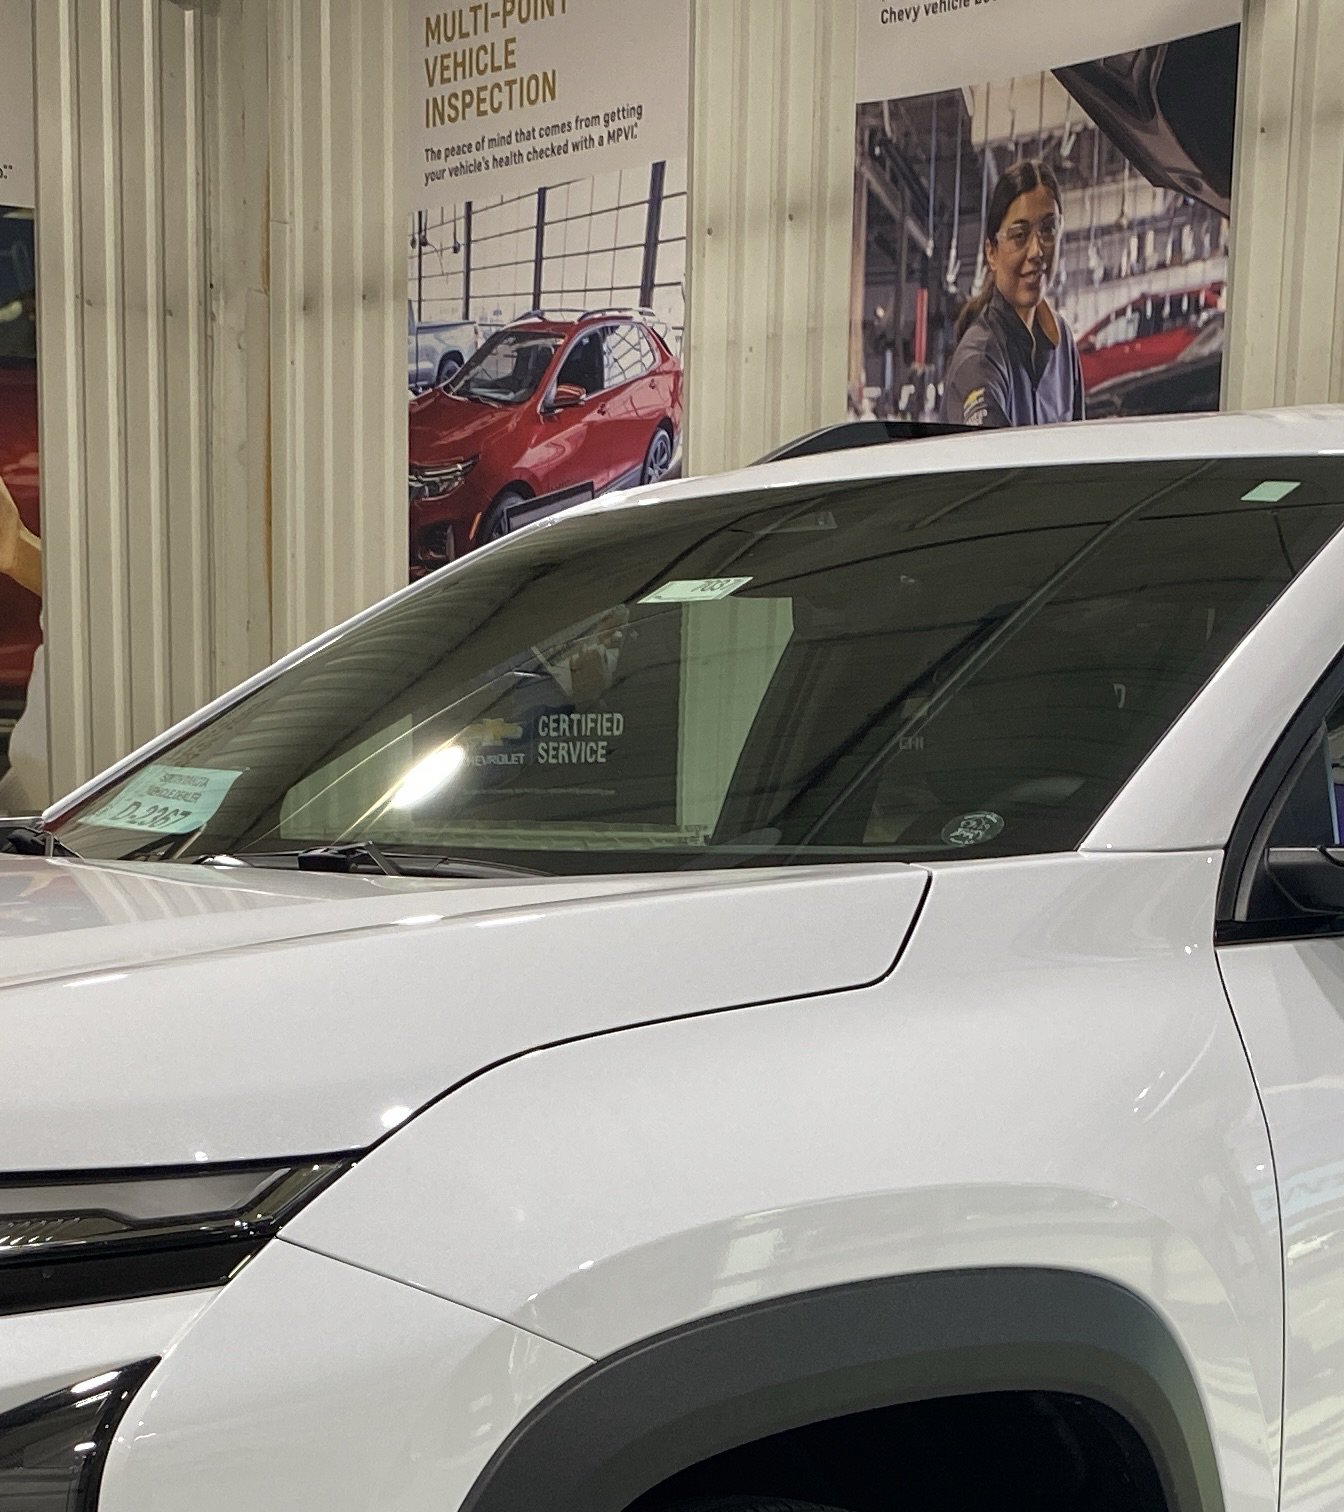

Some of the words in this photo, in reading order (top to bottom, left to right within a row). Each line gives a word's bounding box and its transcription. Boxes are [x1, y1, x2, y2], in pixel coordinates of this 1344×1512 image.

[880, 5, 921, 24] Chevy
[923, 0, 970, 16] vehicle
[424, 36, 517, 88] VEHICLE
[425, 68, 557, 129] INSPECTION
[424, 148, 442, 163] The
[444, 142, 473, 163] peace
[475, 135, 486, 151] of
[487, 129, 513, 149] mind
[514, 125, 536, 144] that
[538, 120, 572, 138] comes
[574, 115, 601, 131] from
[603, 104, 643, 128] getting
[424, 166, 446, 187] your
[448, 155, 490, 178] vehicle's
[492, 149, 524, 170] health
[526, 139, 569, 163] checked
[571, 133, 595, 153] with
[597, 134, 605, 147] a
[538, 712, 624, 737] CERTIFIED
[538, 741, 608, 764] SERVICE
